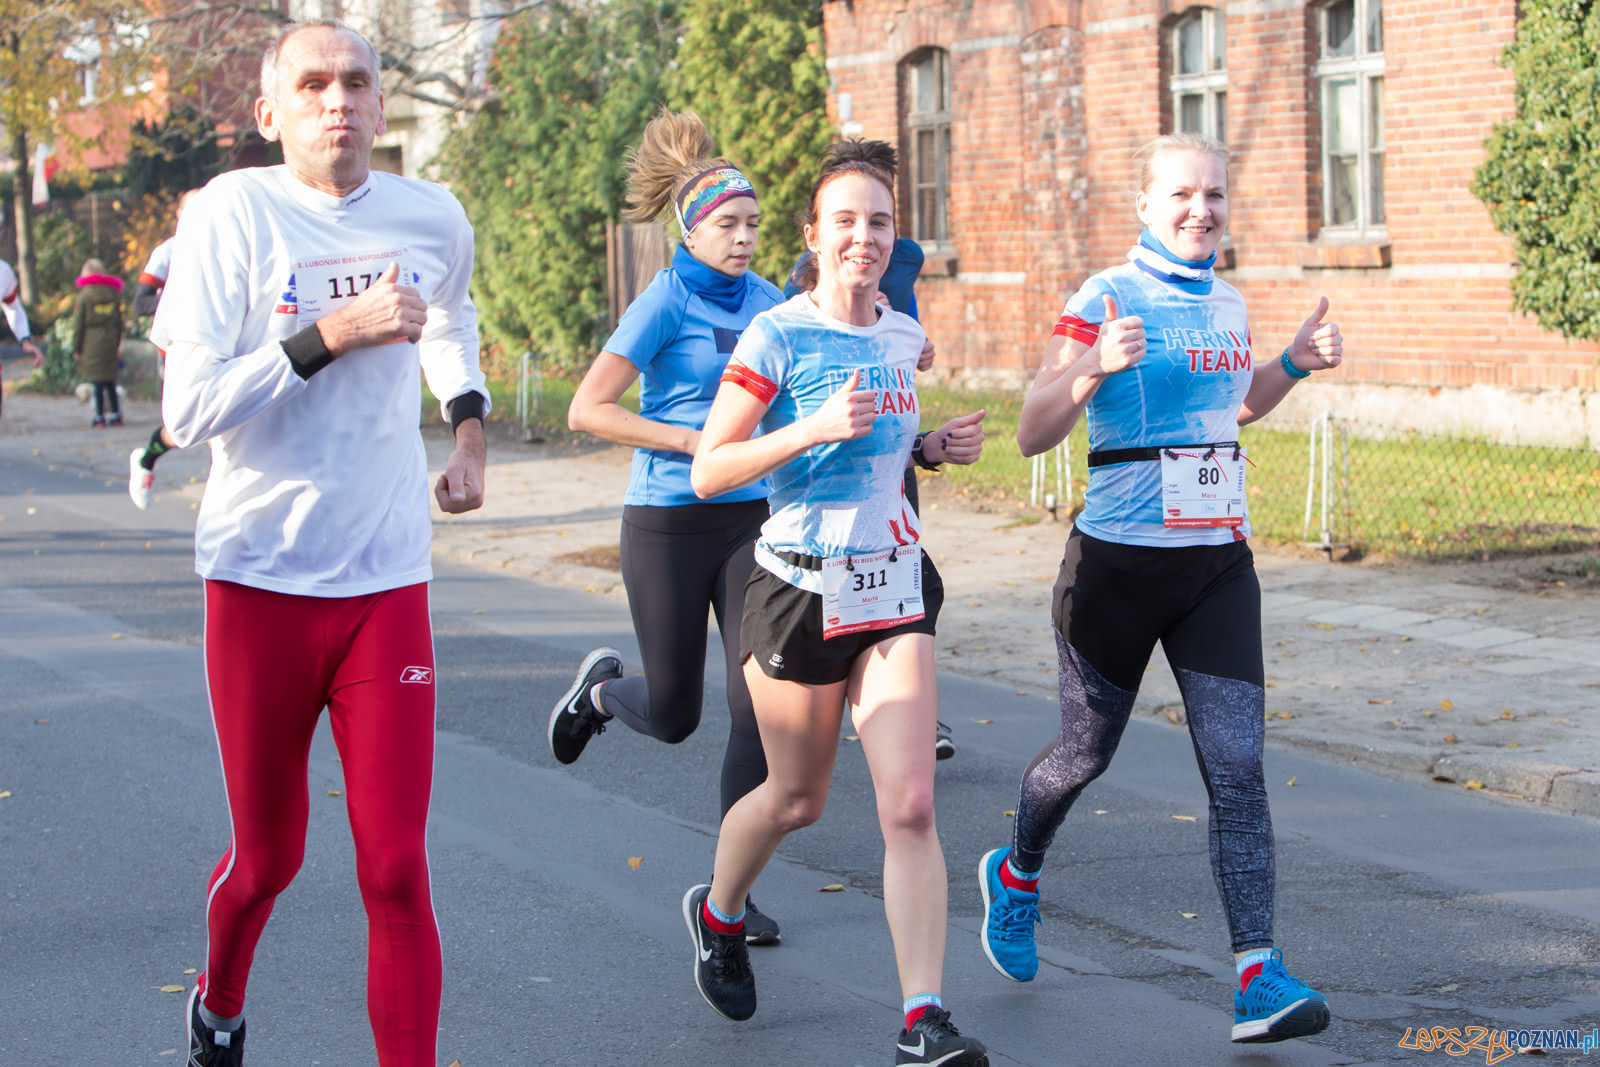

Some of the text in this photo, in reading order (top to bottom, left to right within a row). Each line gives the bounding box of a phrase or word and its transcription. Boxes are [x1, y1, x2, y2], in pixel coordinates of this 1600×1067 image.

[342, 256, 357, 264] BIEG
[328, 272, 383, 299] 117
[1186, 349, 1251, 371] TEAM
[1198, 467, 1219, 485] 80
[853, 569, 887, 591] 311
